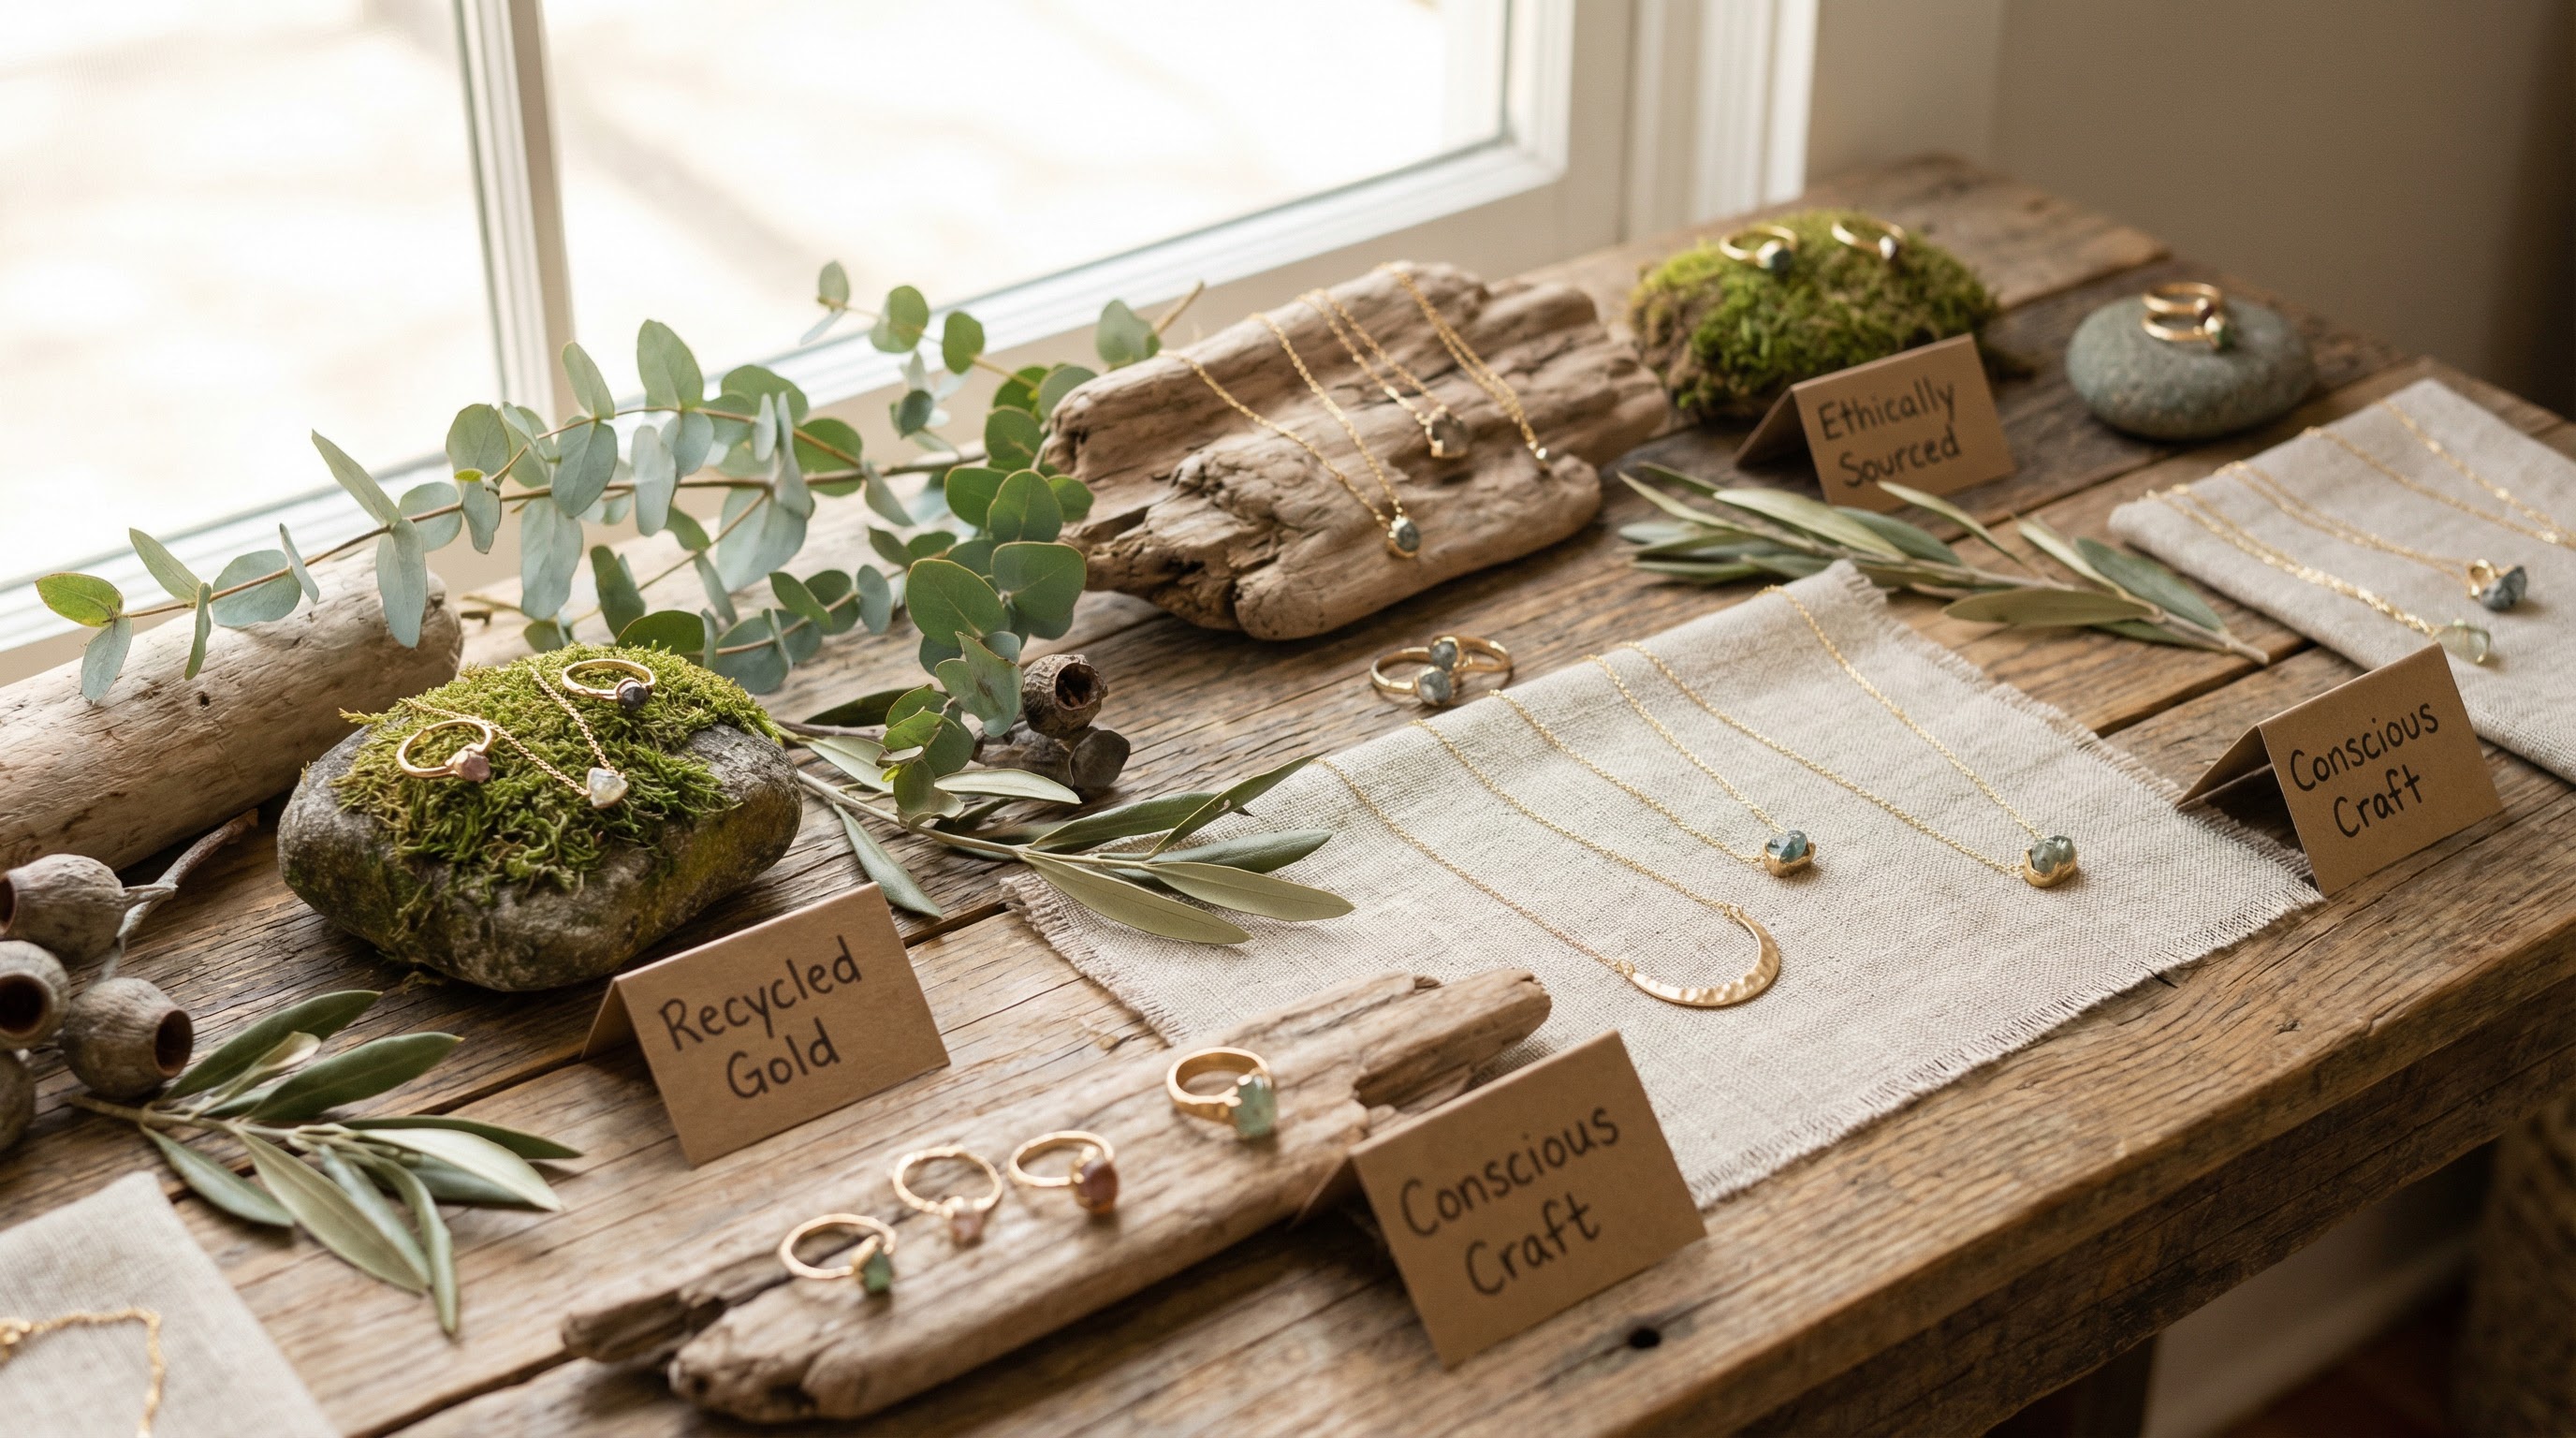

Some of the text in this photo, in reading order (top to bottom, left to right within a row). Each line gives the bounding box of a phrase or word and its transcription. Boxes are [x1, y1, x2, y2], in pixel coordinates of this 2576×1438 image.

[1818, 376, 1955, 441] Ethically
[1838, 423, 1961, 488] Sourced
[2290, 703, 2438, 791] Conscious
[2334, 764, 2422, 838] Craft
[659, 934, 862, 1051] Recycled
[726, 1016, 841, 1098] Gold
[1399, 1107, 1619, 1238] Conscious
[1465, 1191, 1601, 1296] Craft
